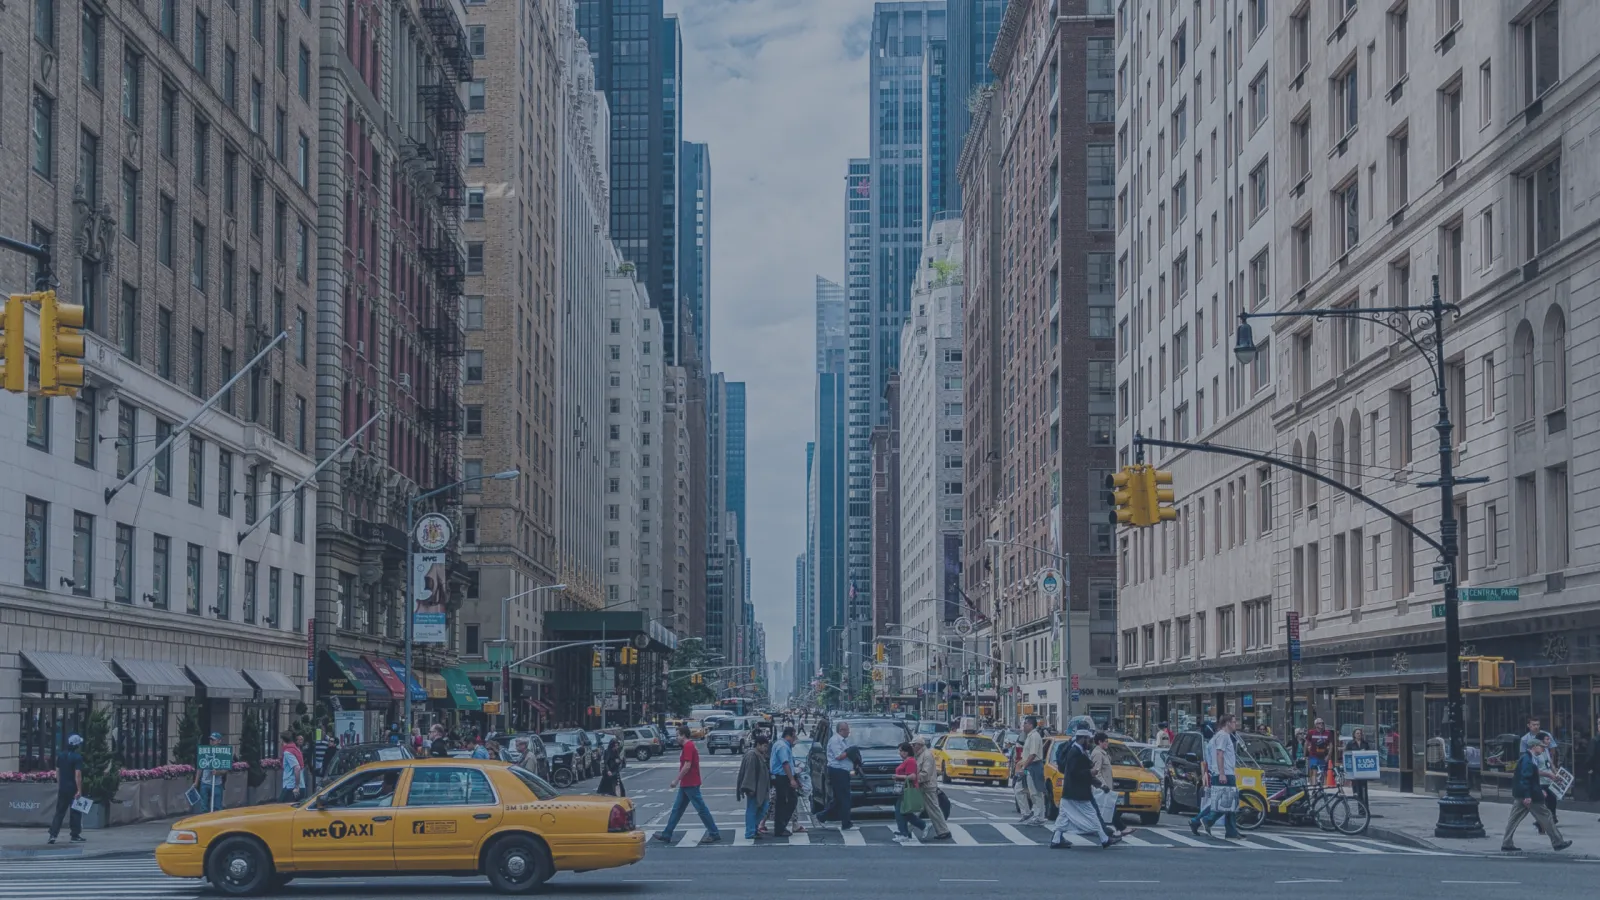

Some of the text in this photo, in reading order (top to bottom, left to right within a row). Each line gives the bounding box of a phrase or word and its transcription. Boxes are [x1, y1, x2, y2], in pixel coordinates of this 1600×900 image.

[1469, 588, 1518, 597] CENTRAL PARK
[212, 747, 231, 755] RENTAL
[8, 801, 40, 809] MARKET
[302, 820, 374, 839] NYC TAXI
